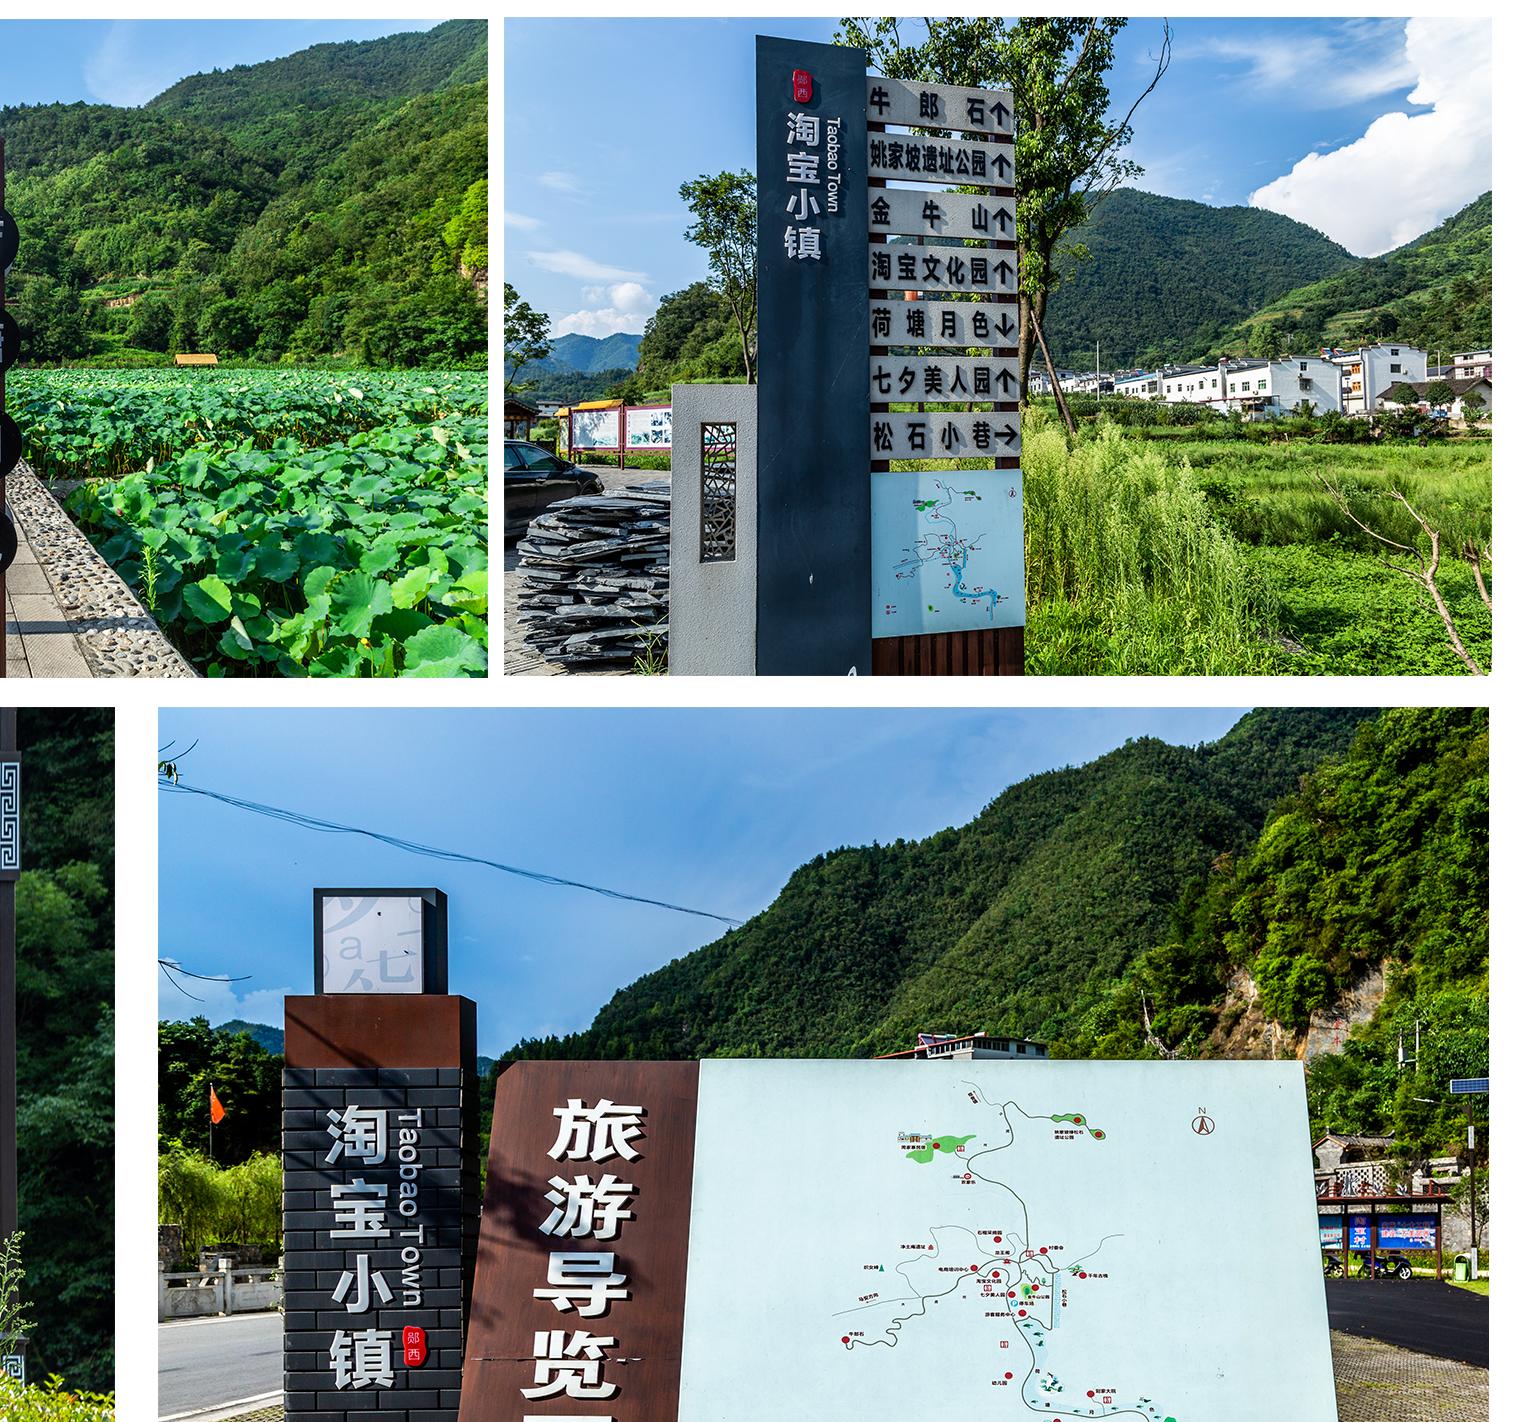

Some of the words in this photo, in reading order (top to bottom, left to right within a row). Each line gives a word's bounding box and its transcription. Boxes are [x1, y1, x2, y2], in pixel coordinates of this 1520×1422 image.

[869, 86, 985, 125] 牛郎石
[827, 117, 841, 170] Taobao
[870, 140, 986, 177] 姚家坡遗址公园
[784, 112, 821, 261] 淘宝小镇
[827, 173, 841, 213] Town
[871, 196, 988, 233] 金牛山
[872, 251, 988, 285] 淘宝文化园
[872, 307, 990, 339] 荷塘月色
[872, 365, 991, 395] 七夕美人园
[873, 421, 991, 451] 松石小巷
[398, 1108, 423, 1217] Taobao
[325, 1105, 395, 1390] 淘宝小镇
[400, 1224, 424, 1306] Town
[408, 1332, 420, 1361] 郧西
